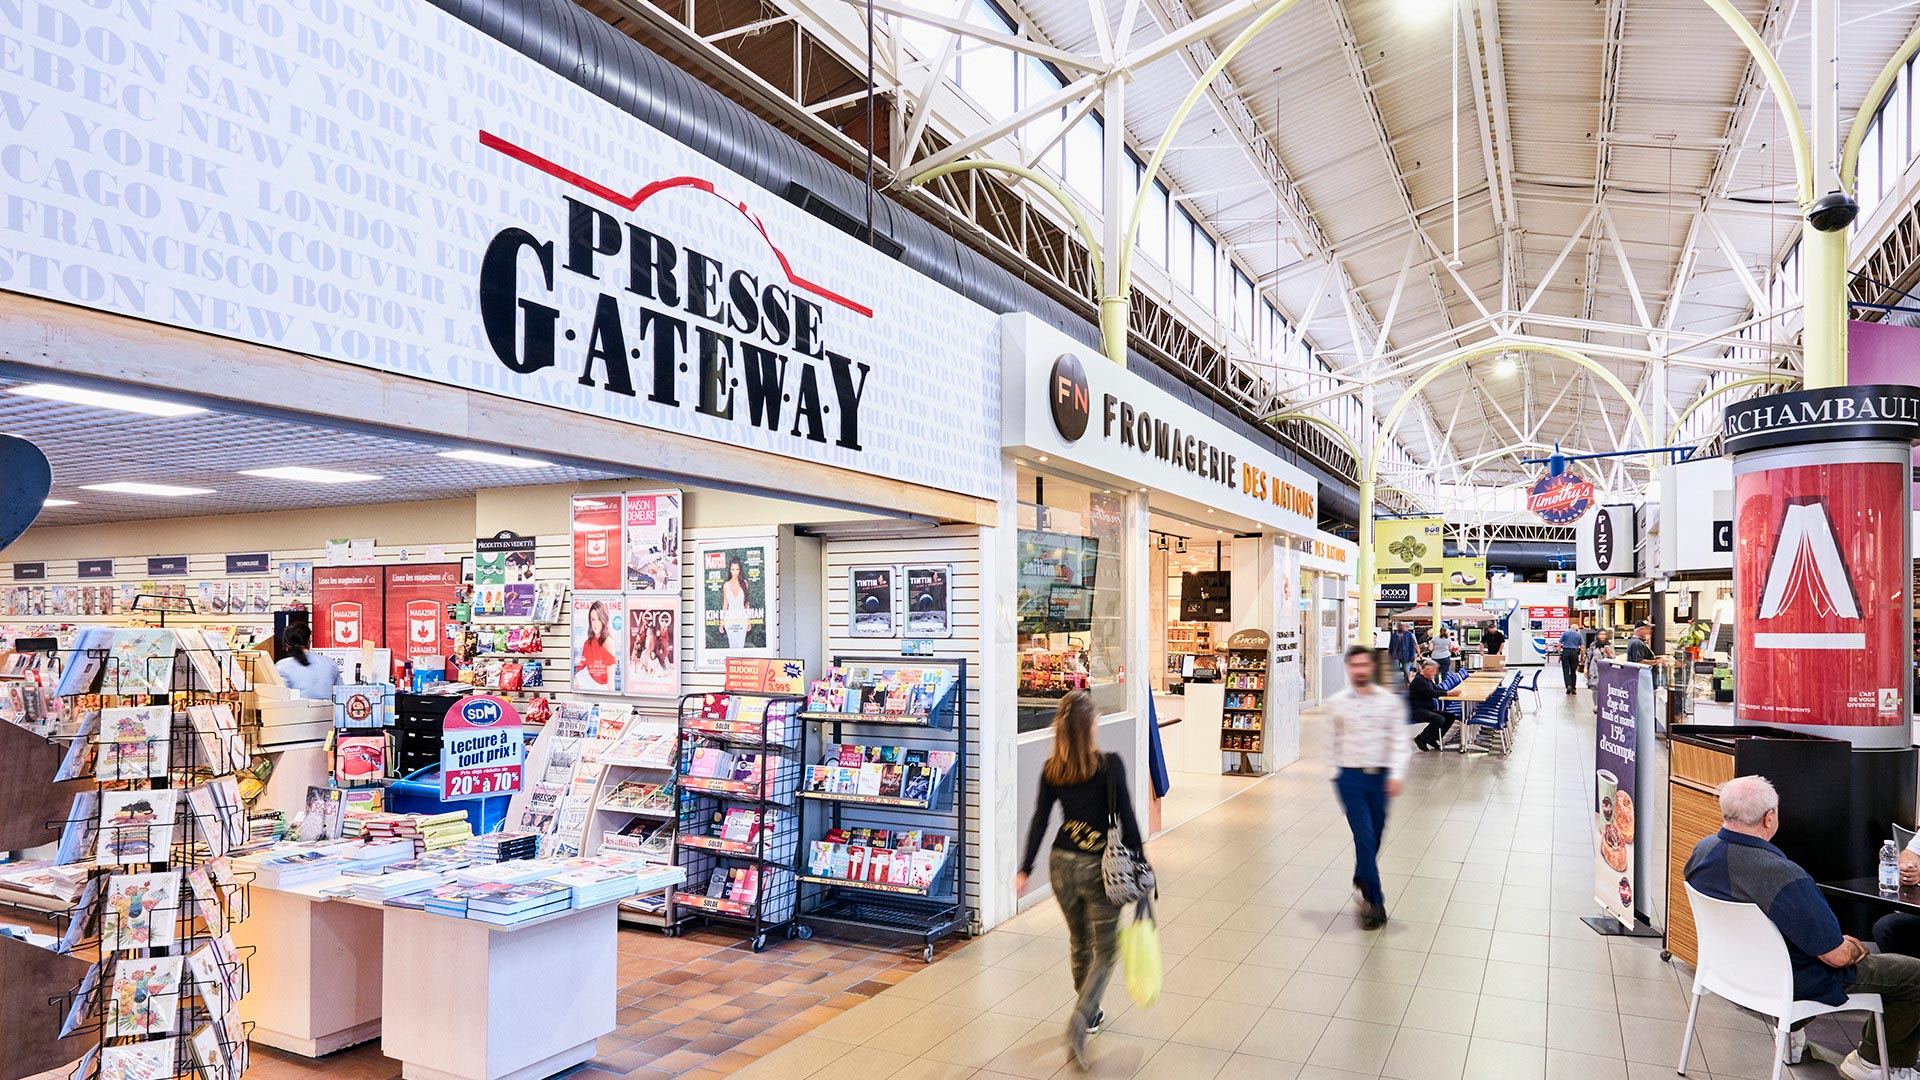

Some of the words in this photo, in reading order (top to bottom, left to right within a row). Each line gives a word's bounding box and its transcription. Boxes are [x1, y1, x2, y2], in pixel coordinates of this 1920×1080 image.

[294, 20, 426, 109] BOSTON
[174, 9, 303, 95] NEW
[315, 71, 437, 151] YORK
[186, 61, 273, 126] SAN
[288, 102, 488, 208] FRANCISCO
[177, 101, 293, 175] NEW
[308, 150, 422, 219] YORK
[60, 110, 229, 199] YORK
[255, 176, 418, 259] LONDON
[1, 140, 161, 225] CAGO
[177, 195, 449, 305] VANCOUVER
[7, 193, 281, 300] FRANCISCO
[290, 271, 426, 336] BOSTON
[562, 195, 824, 360] PRESSE
[168, 285, 292, 346] NEW
[311, 319, 433, 376] YORK
[446, 351, 594, 410] CHICAGO
[602, 388, 702, 433] BOSTON
[709, 414, 758, 445] NEW
[1104, 393, 1236, 489] FROMAGERIE
[1243, 462, 1267, 501] DES
[1272, 476, 1314, 520] NATIONS
[627, 501, 650, 511] MAISON
[1528, 482, 1590, 510] Timothy's
[627, 510, 655, 521] DEMEURE
[1598, 515, 1608, 564] PIZZA
[414, 573, 441, 583] magazines
[856, 579, 878, 587] TINTIN
[909, 577, 932, 585] TINTIN
[409, 609, 436, 617] MAGAZINE
[705, 610, 719, 621] KIM
[729, 665, 759, 674] SUDOKU
[768, 668, 776, 683] 2
[467, 704, 497, 720] SDM
[451, 734, 497, 755] Lecture
[500, 730, 507, 744] à
[1611, 724, 1625, 743] 15%
[459, 750, 484, 768] tout
[487, 745, 510, 763] prix
[482, 777, 490, 793] à
[703, 899, 718, 908] SOLDE
